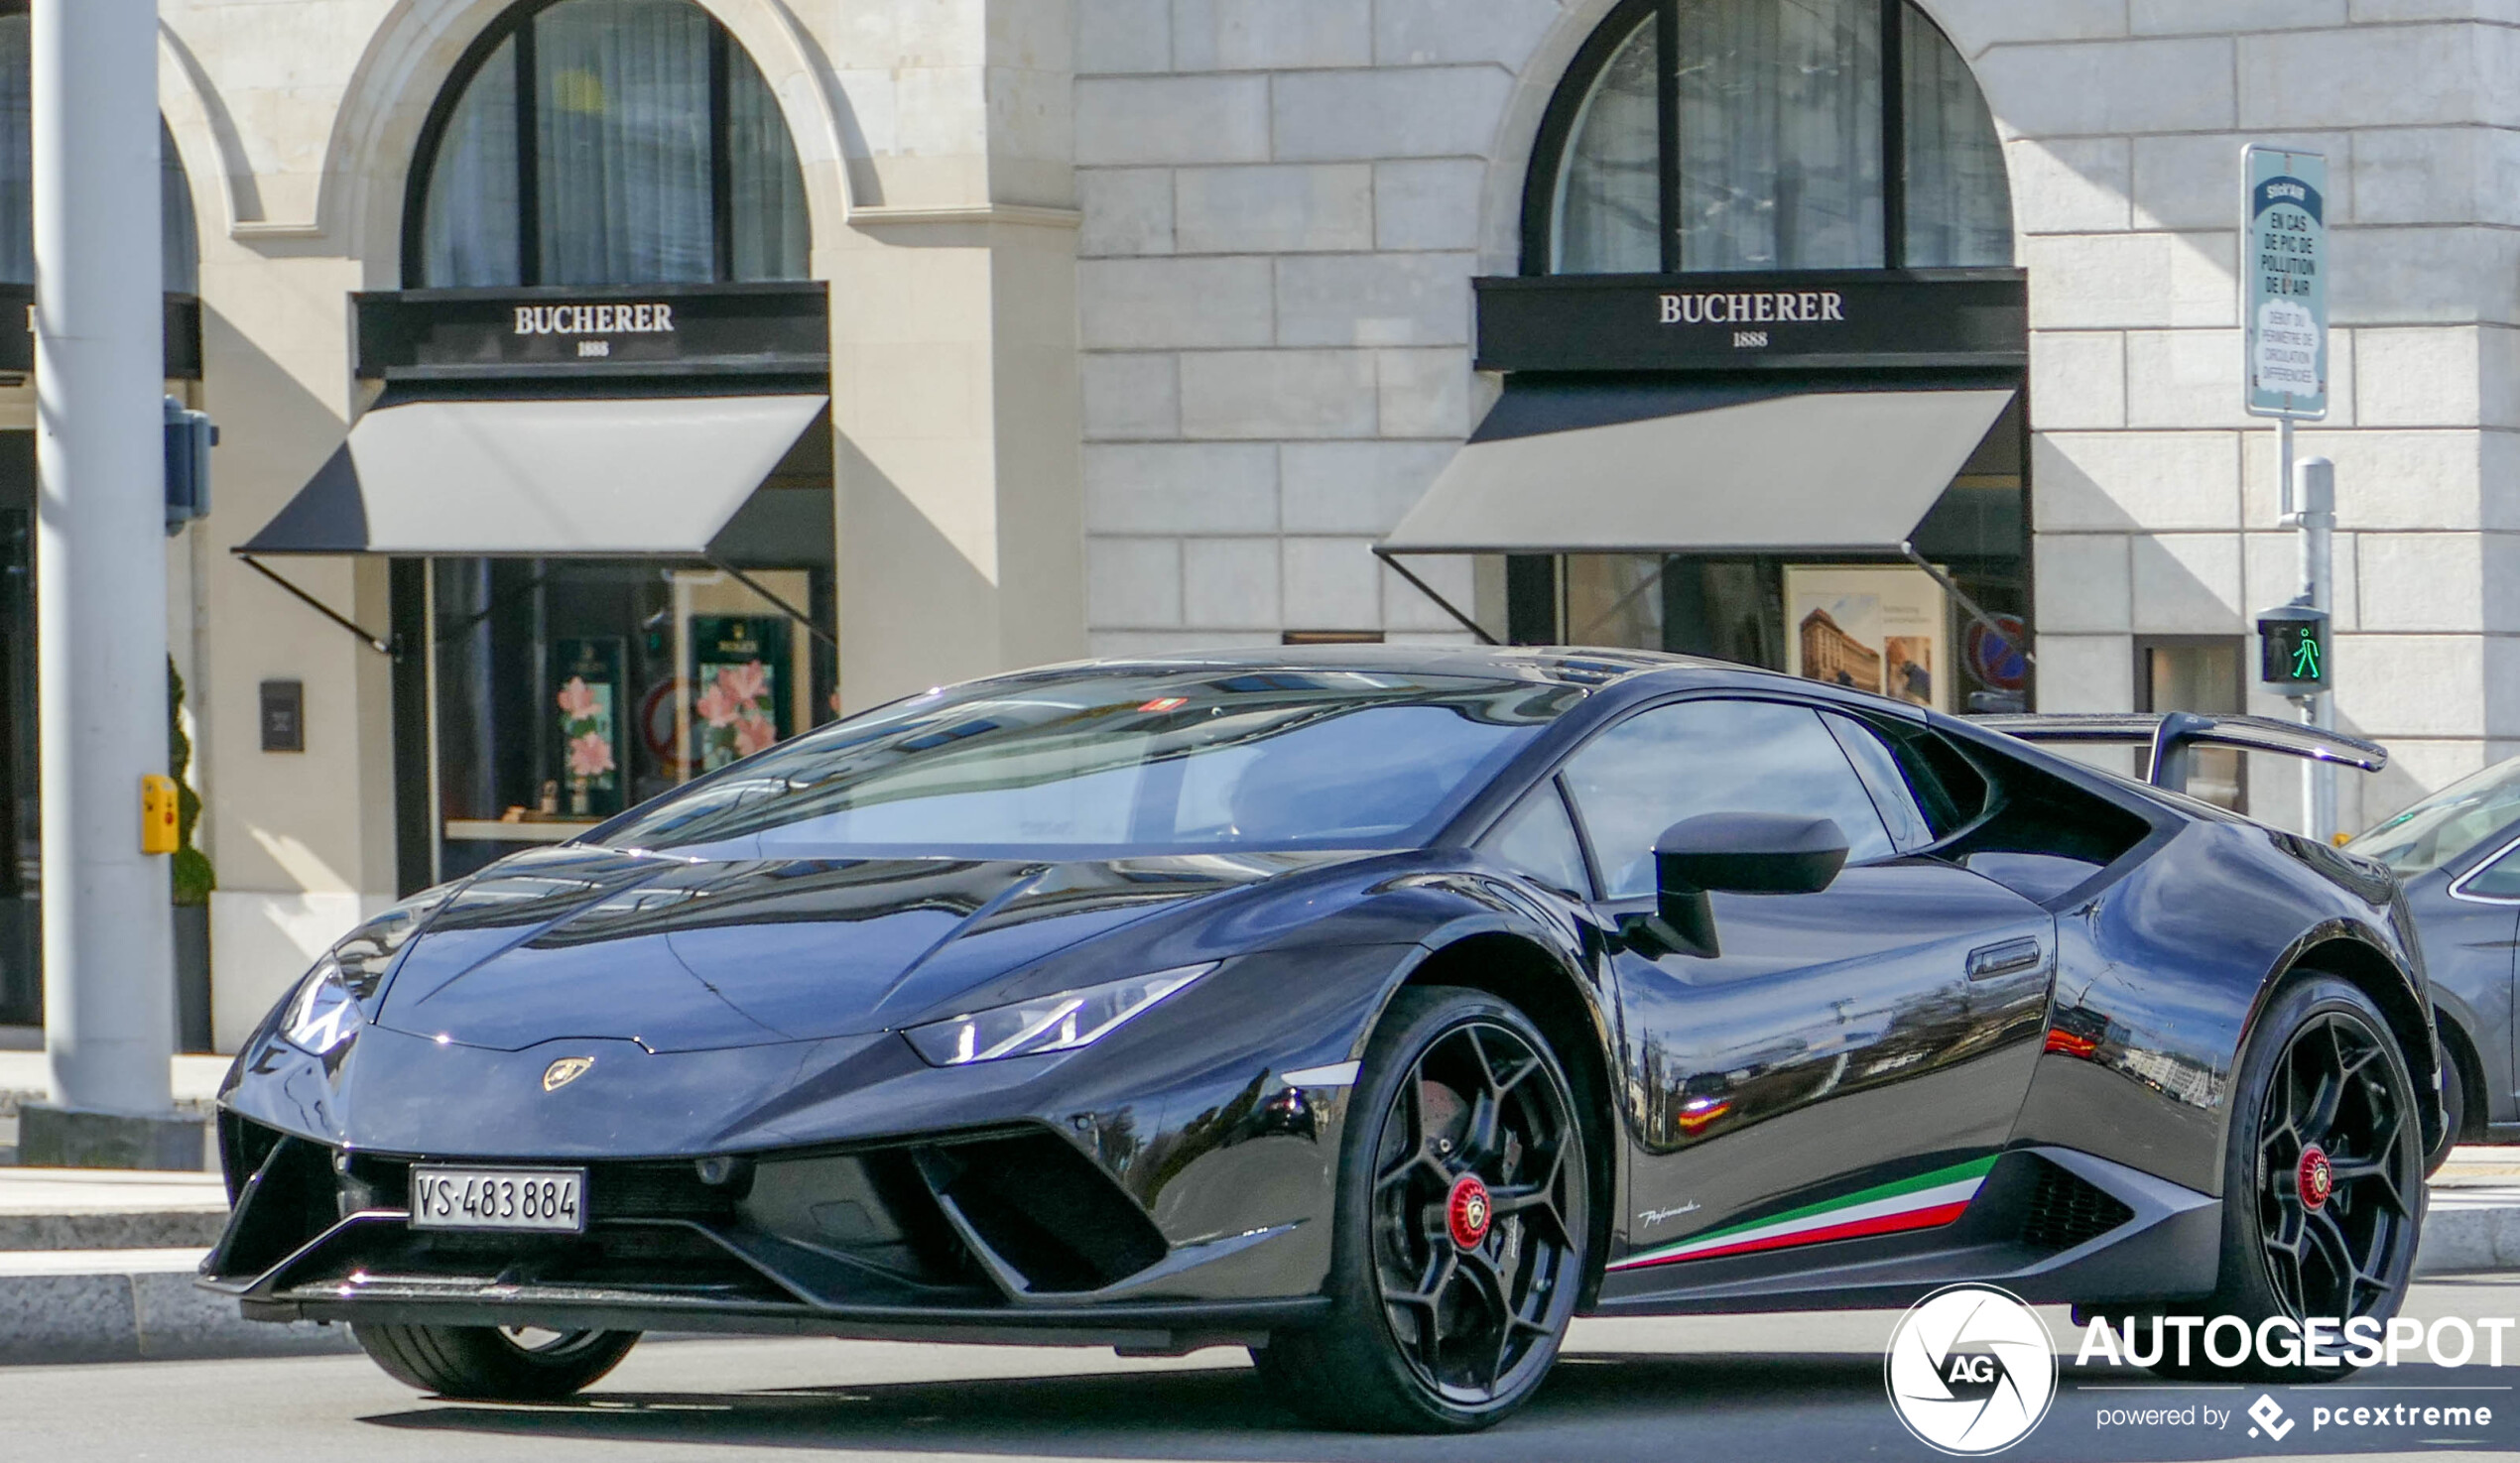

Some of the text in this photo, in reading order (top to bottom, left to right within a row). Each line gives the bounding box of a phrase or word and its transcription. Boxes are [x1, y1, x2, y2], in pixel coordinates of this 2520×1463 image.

[2271, 212, 2307, 232] EN CAS
[2265, 233, 2313, 254] DE PIC DE
[2261, 254, 2316, 276] POLLUTION
[2266, 276, 2279, 293] DE
[1659, 292, 1845, 323] BUCHERER
[514, 304, 675, 334] BUCHERER
[577, 340, 610, 357] 1888
[1732, 331, 1769, 348] 1888
